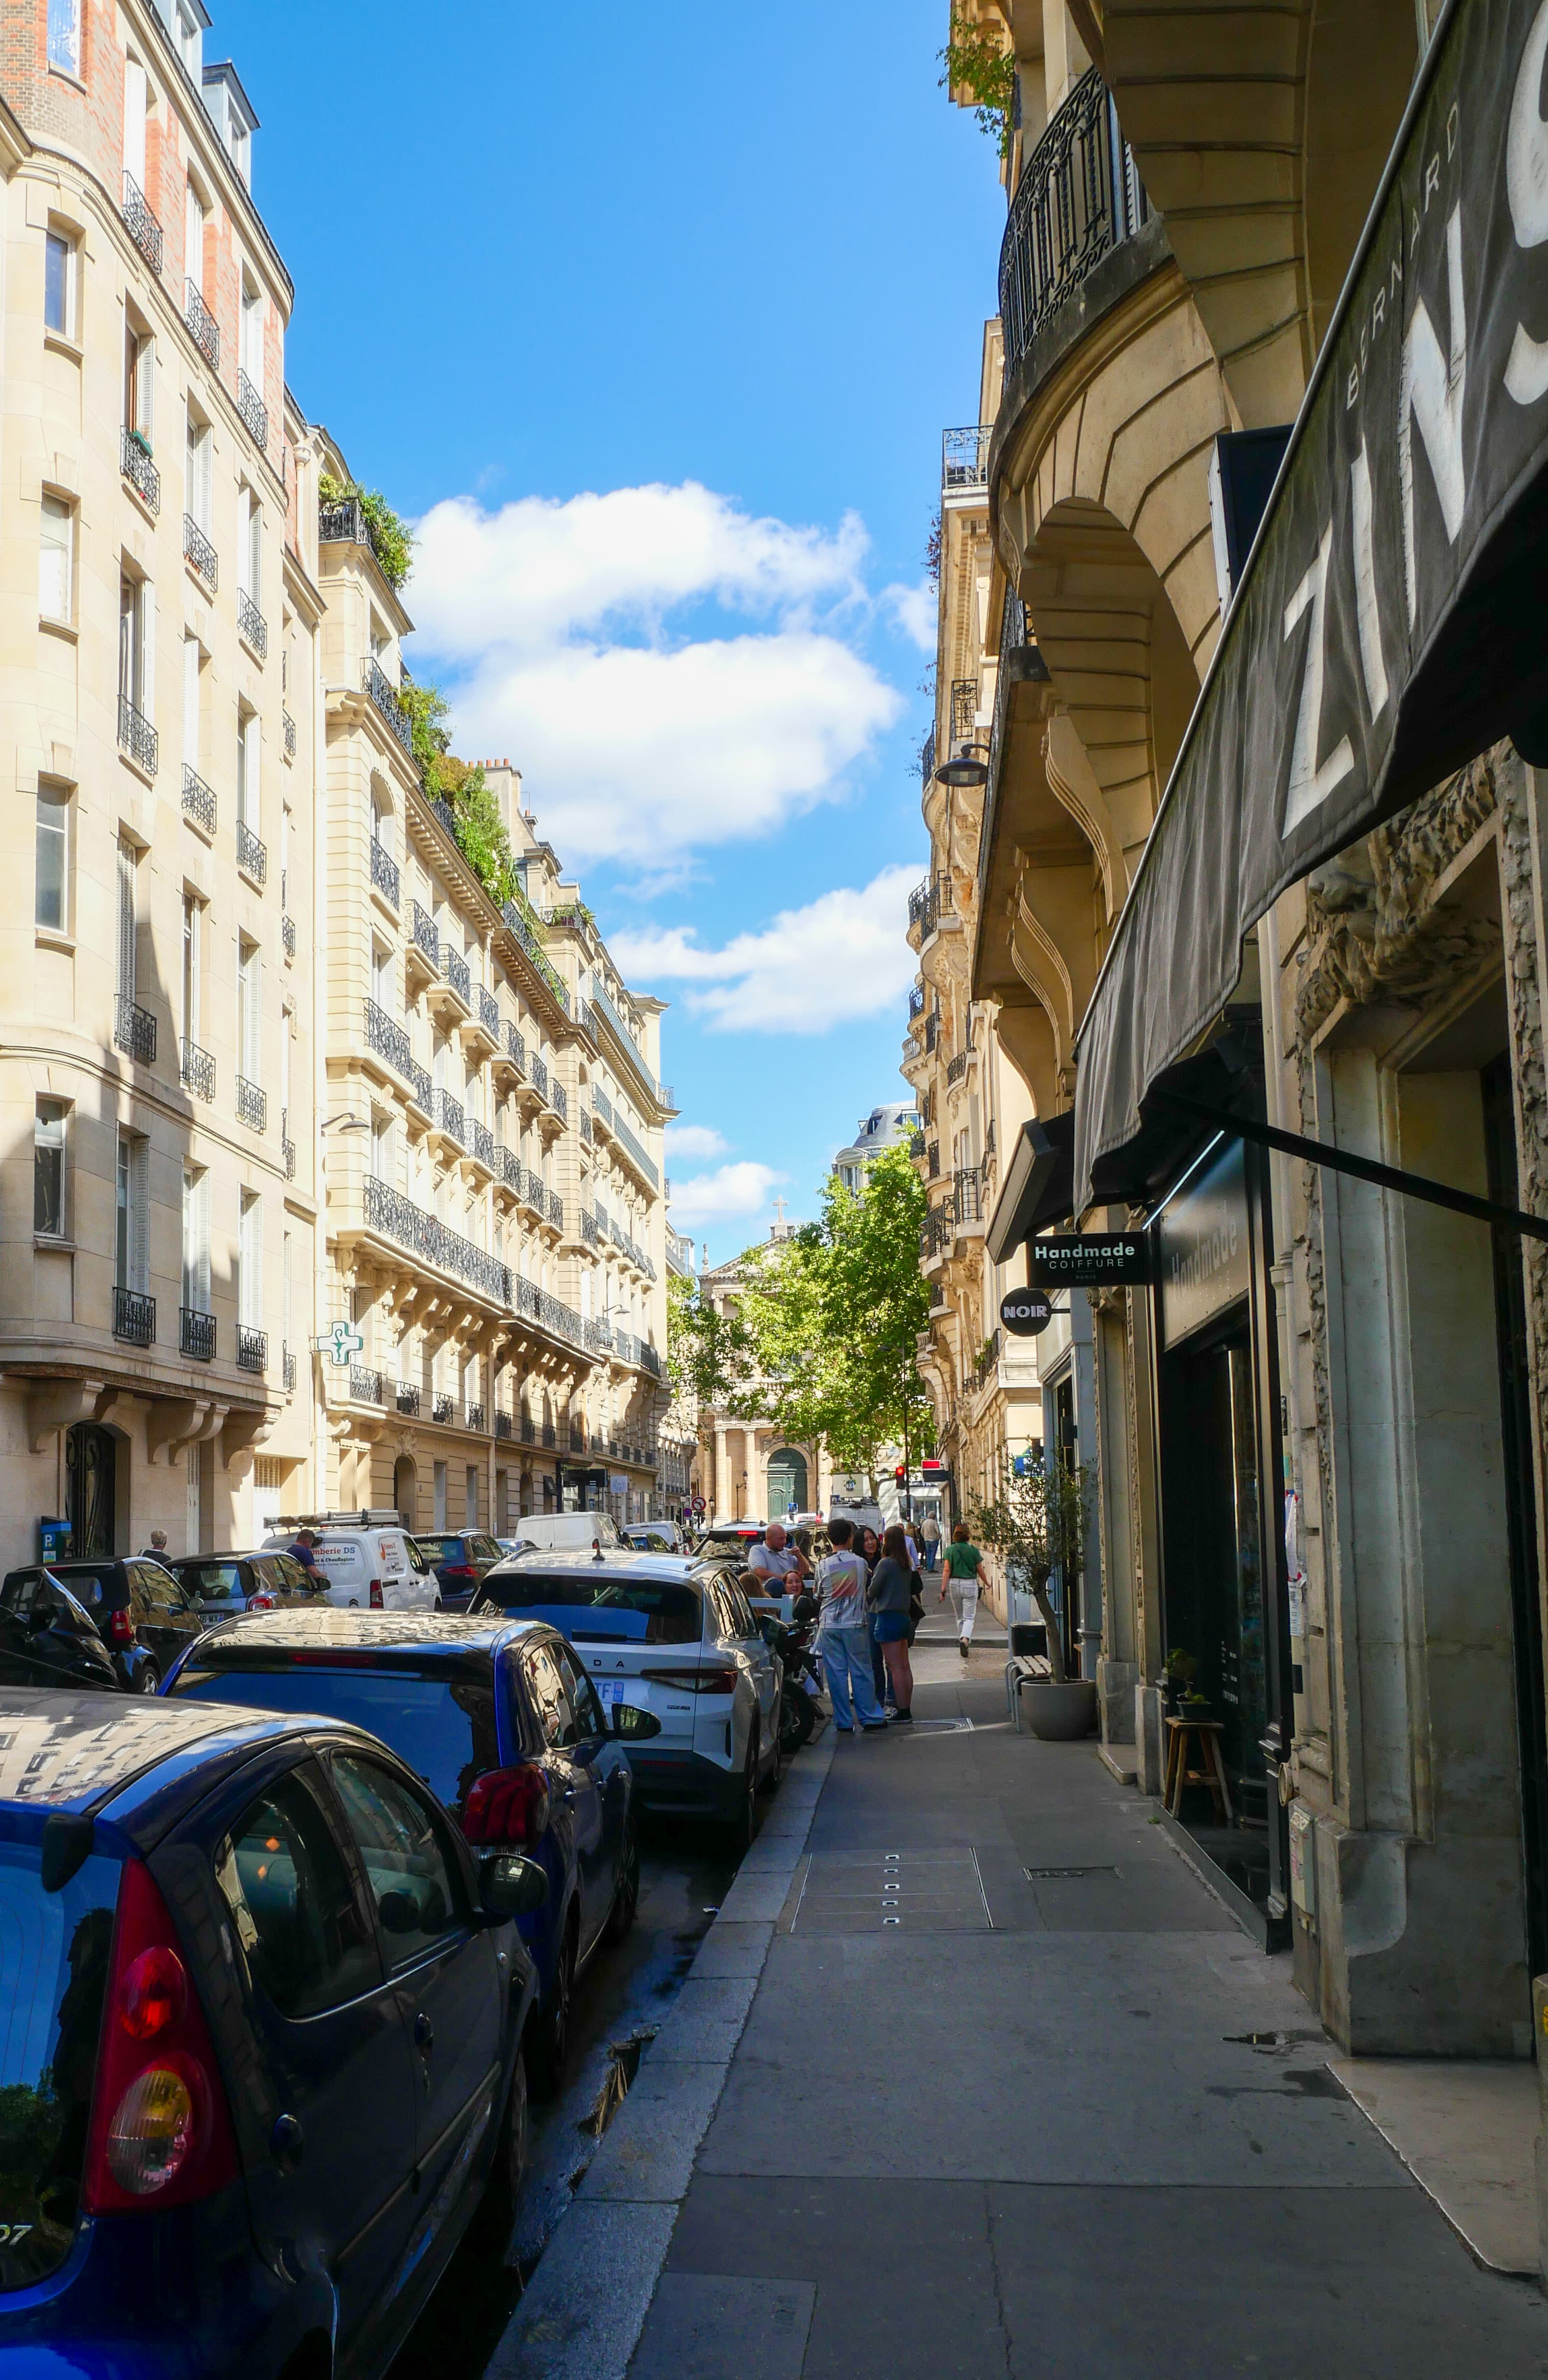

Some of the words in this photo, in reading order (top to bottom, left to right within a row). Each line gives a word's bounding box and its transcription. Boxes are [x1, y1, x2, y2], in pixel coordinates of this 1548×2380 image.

[1347, 102, 1459, 411] BERNARD
[1035, 1242, 1135, 1259] Handmade
[1172, 1200, 1237, 1303] Handmade
[1049, 1253, 1124, 1269] COIFFURE
[1003, 1305, 1048, 1318] NOIR
